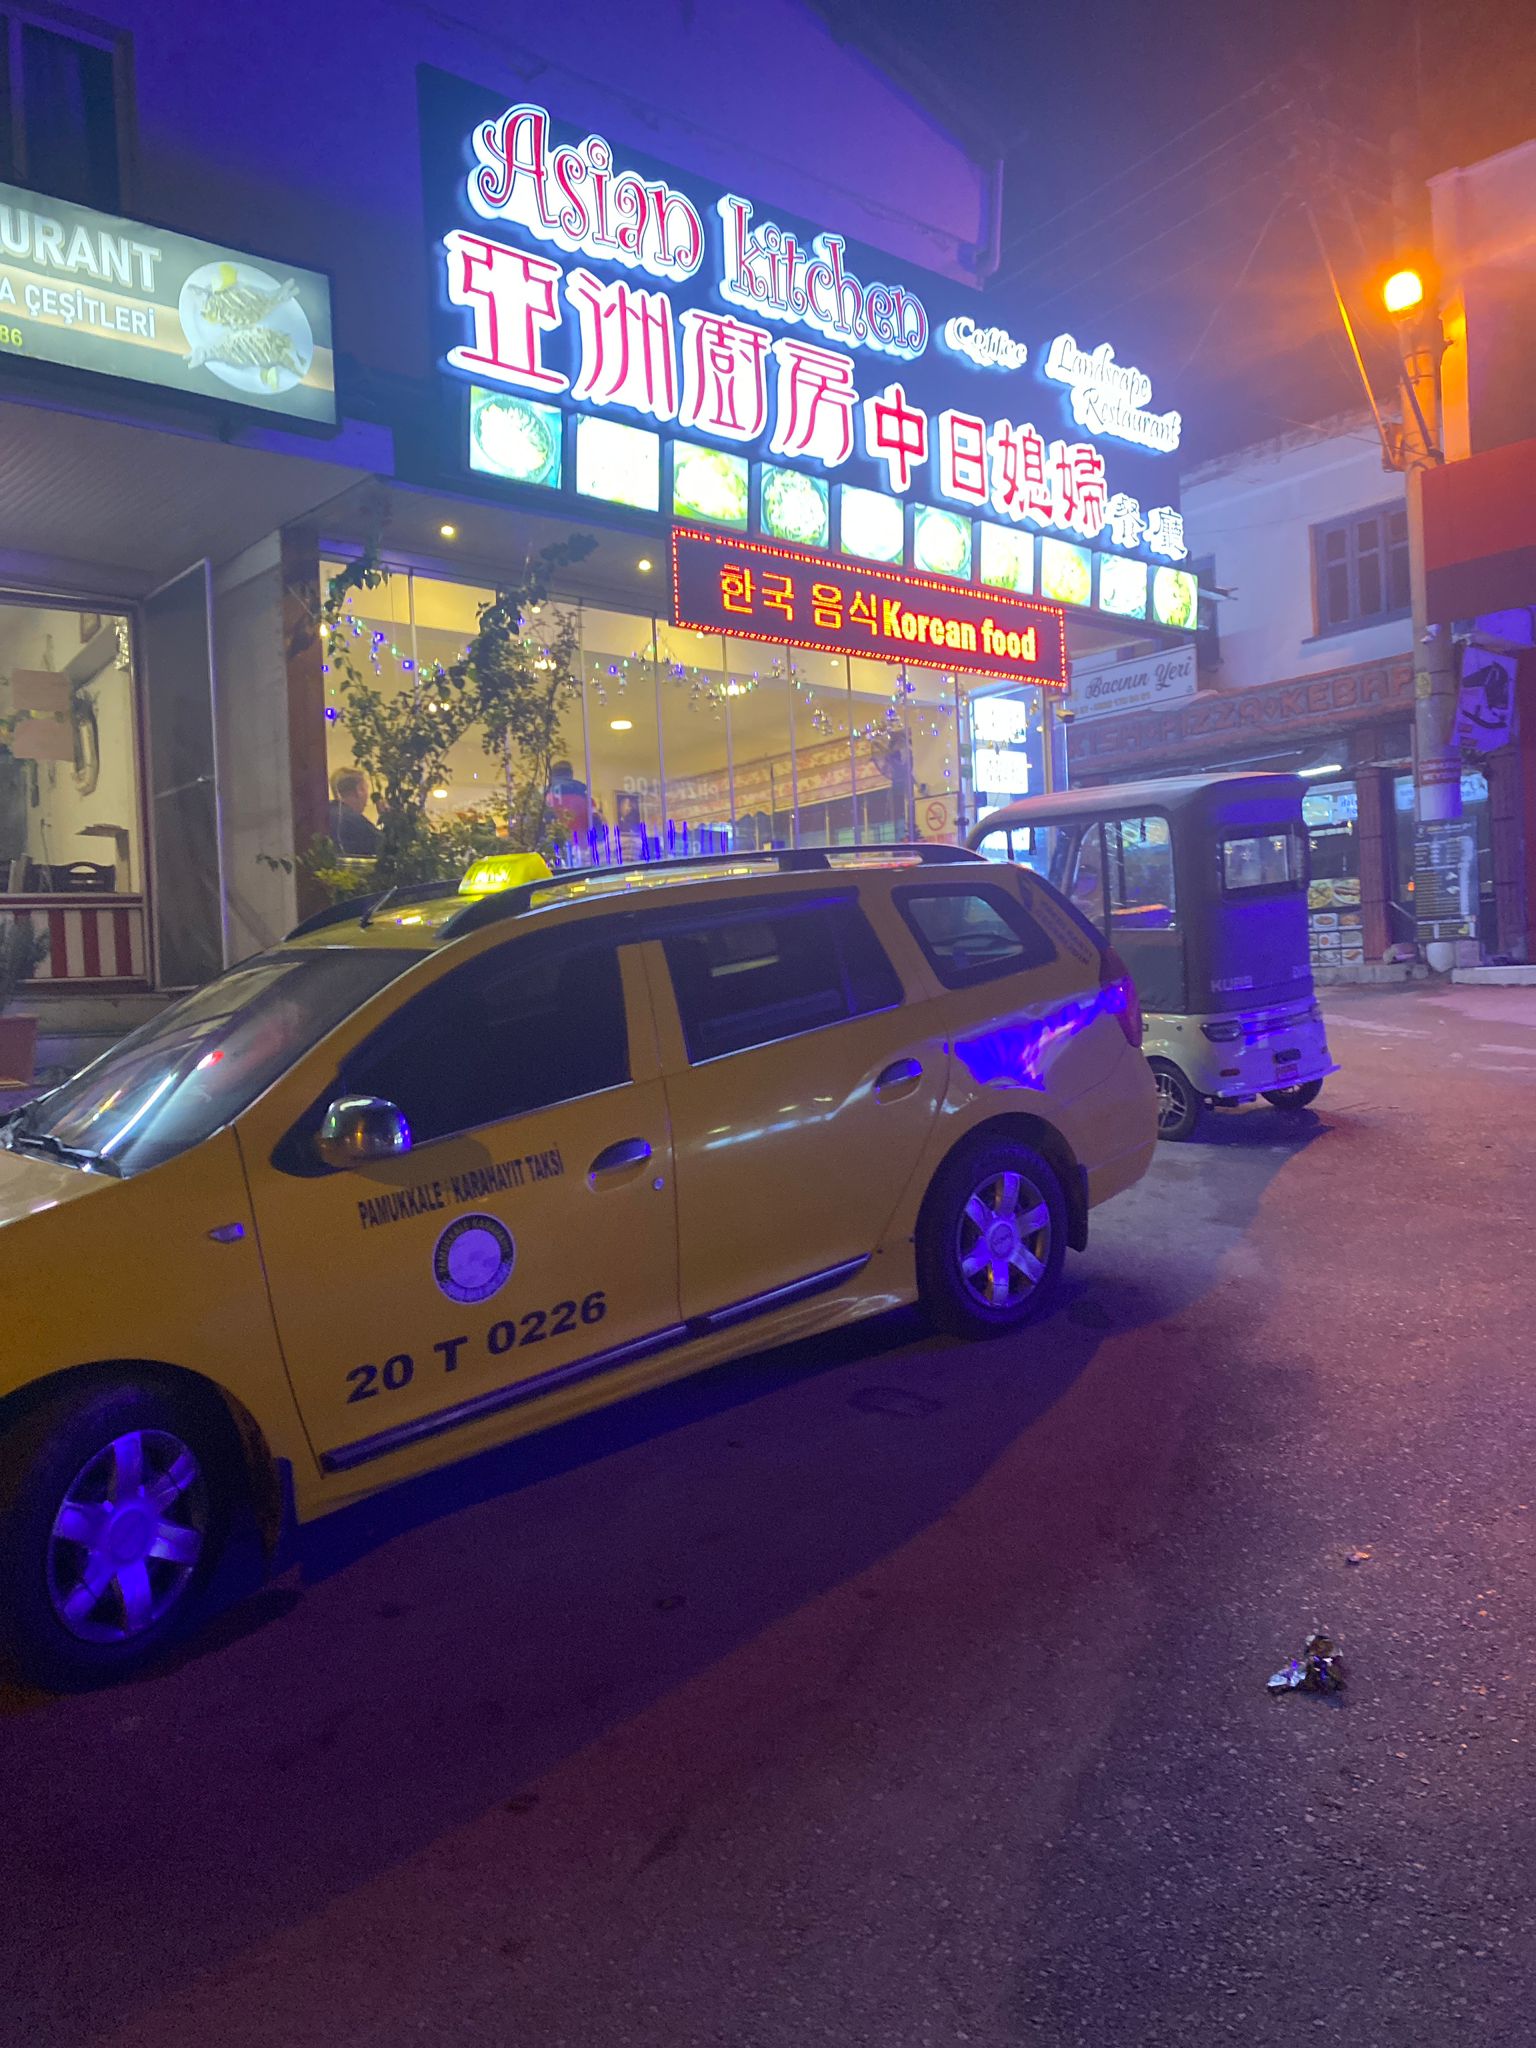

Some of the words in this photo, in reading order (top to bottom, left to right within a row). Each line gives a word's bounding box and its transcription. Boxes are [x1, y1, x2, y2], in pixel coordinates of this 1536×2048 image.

[0, 204, 162, 293] URANT
[476, 104, 705, 274] Asian
[727, 197, 928, 351] kitchen
[25, 284, 156, 339] ÇEŞİTLERİ
[1057, 338, 1149, 404] Landscape
[1083, 387, 1178, 444] Restaurant
[720, 563, 795, 623] 한국
[980, 616, 1038, 663] food
[1154, 656, 1192, 691] Yeri
[1279, 664, 1415, 718] KEBAP
[358, 1180, 445, 1229] PAMUKKALE
[345, 1353, 415, 1404] 20
[433, 1335, 470, 1373] T
[486, 1290, 607, 1356] 0226
